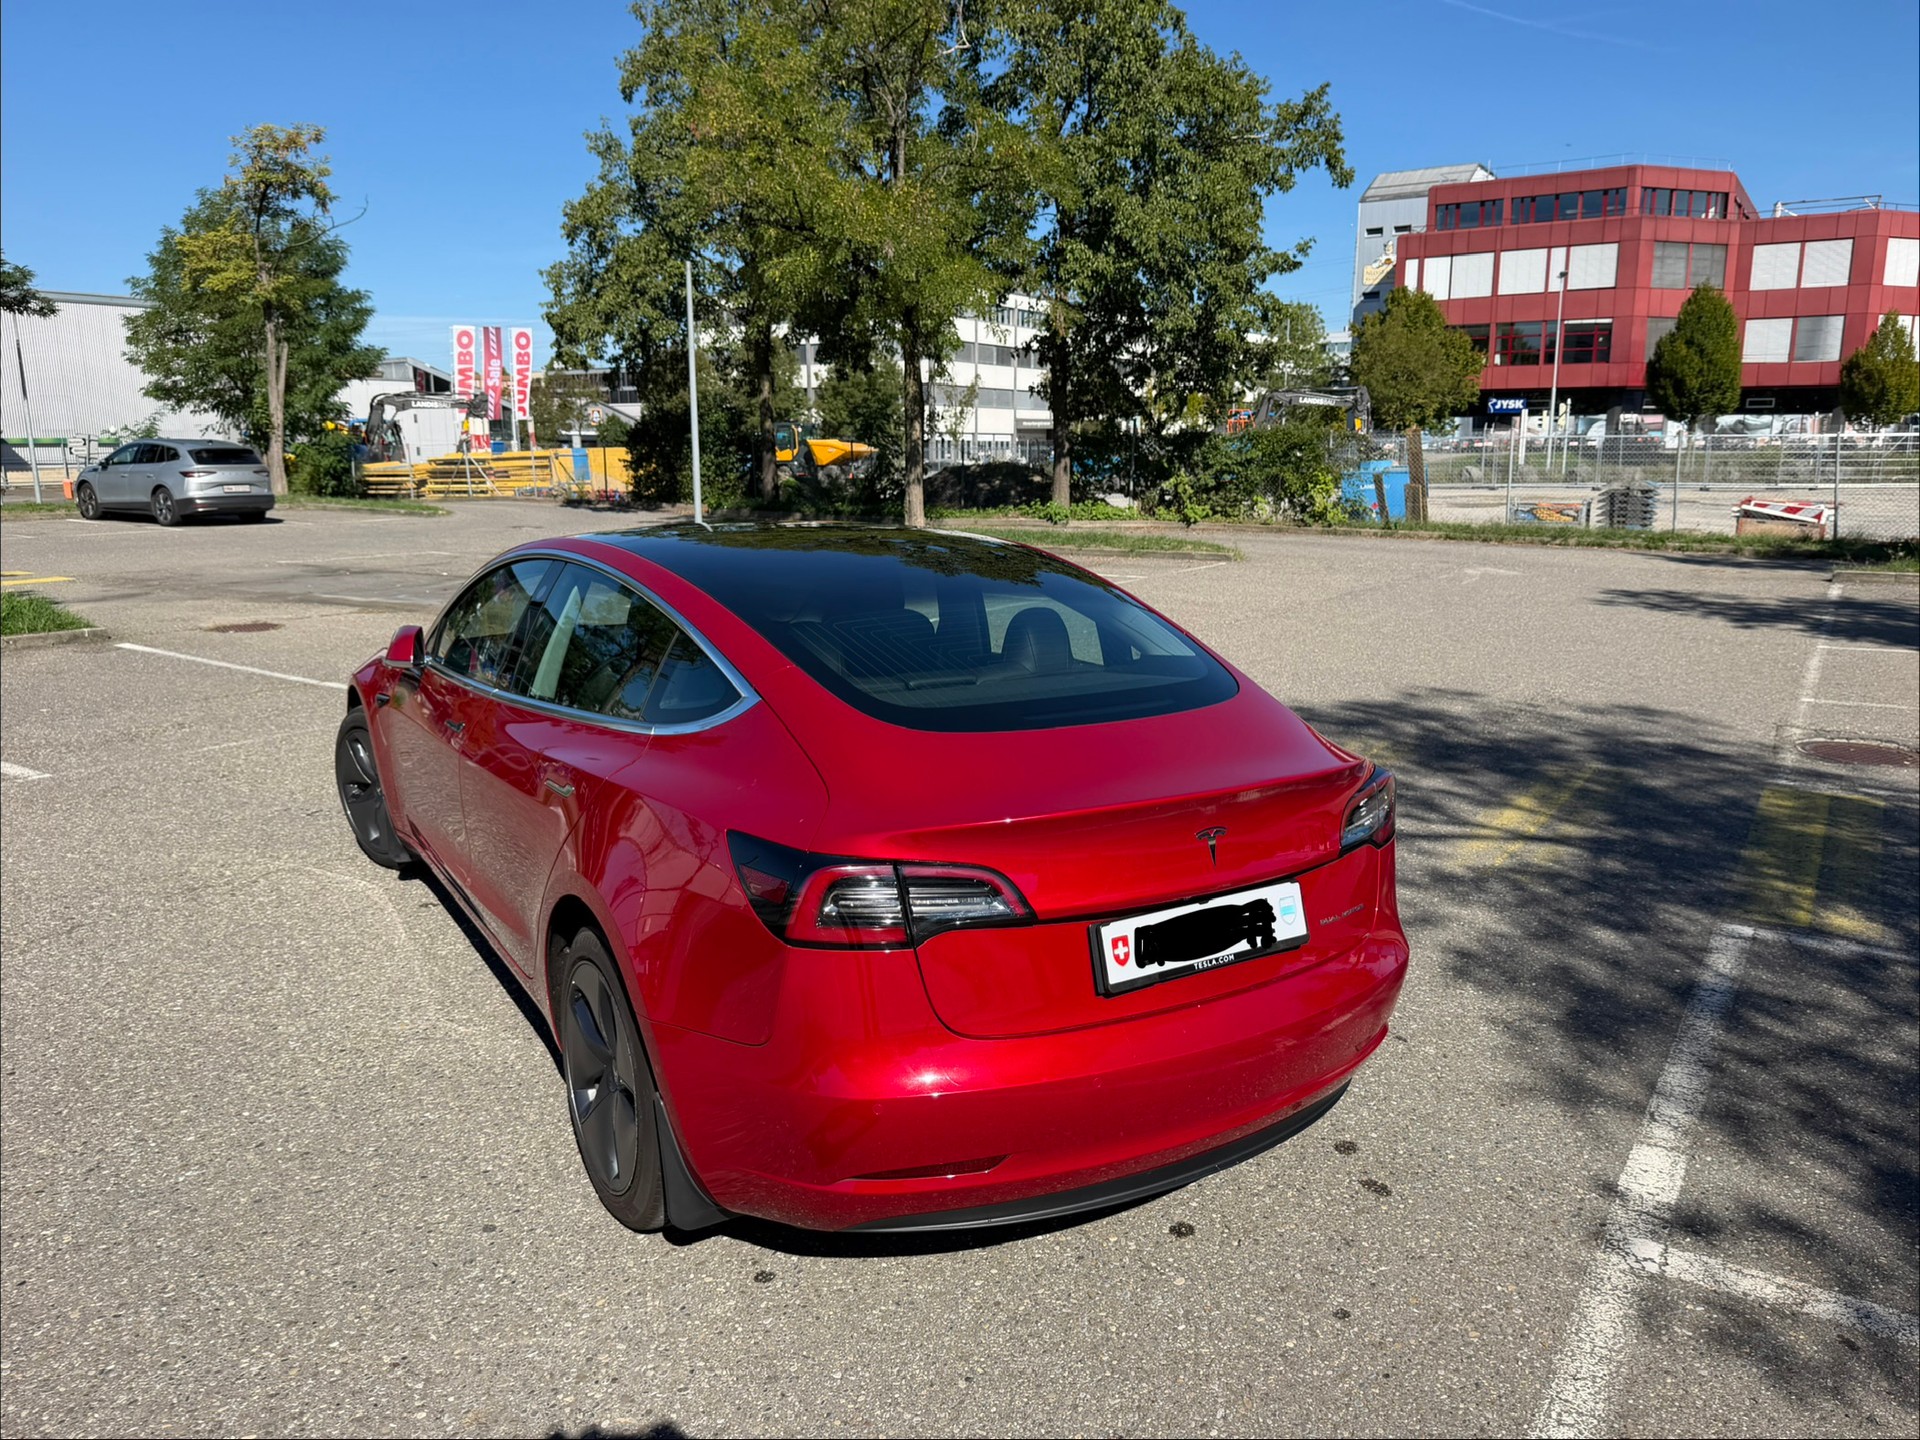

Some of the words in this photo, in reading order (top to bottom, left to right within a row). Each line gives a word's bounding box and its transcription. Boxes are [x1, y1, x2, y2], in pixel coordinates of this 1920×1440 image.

[486, 358, 501, 387] Sale
[515, 331, 531, 417] JUMBO
[1495, 399, 1524, 409] JYSK
[1194, 954, 1235, 970] TESLA.COM
